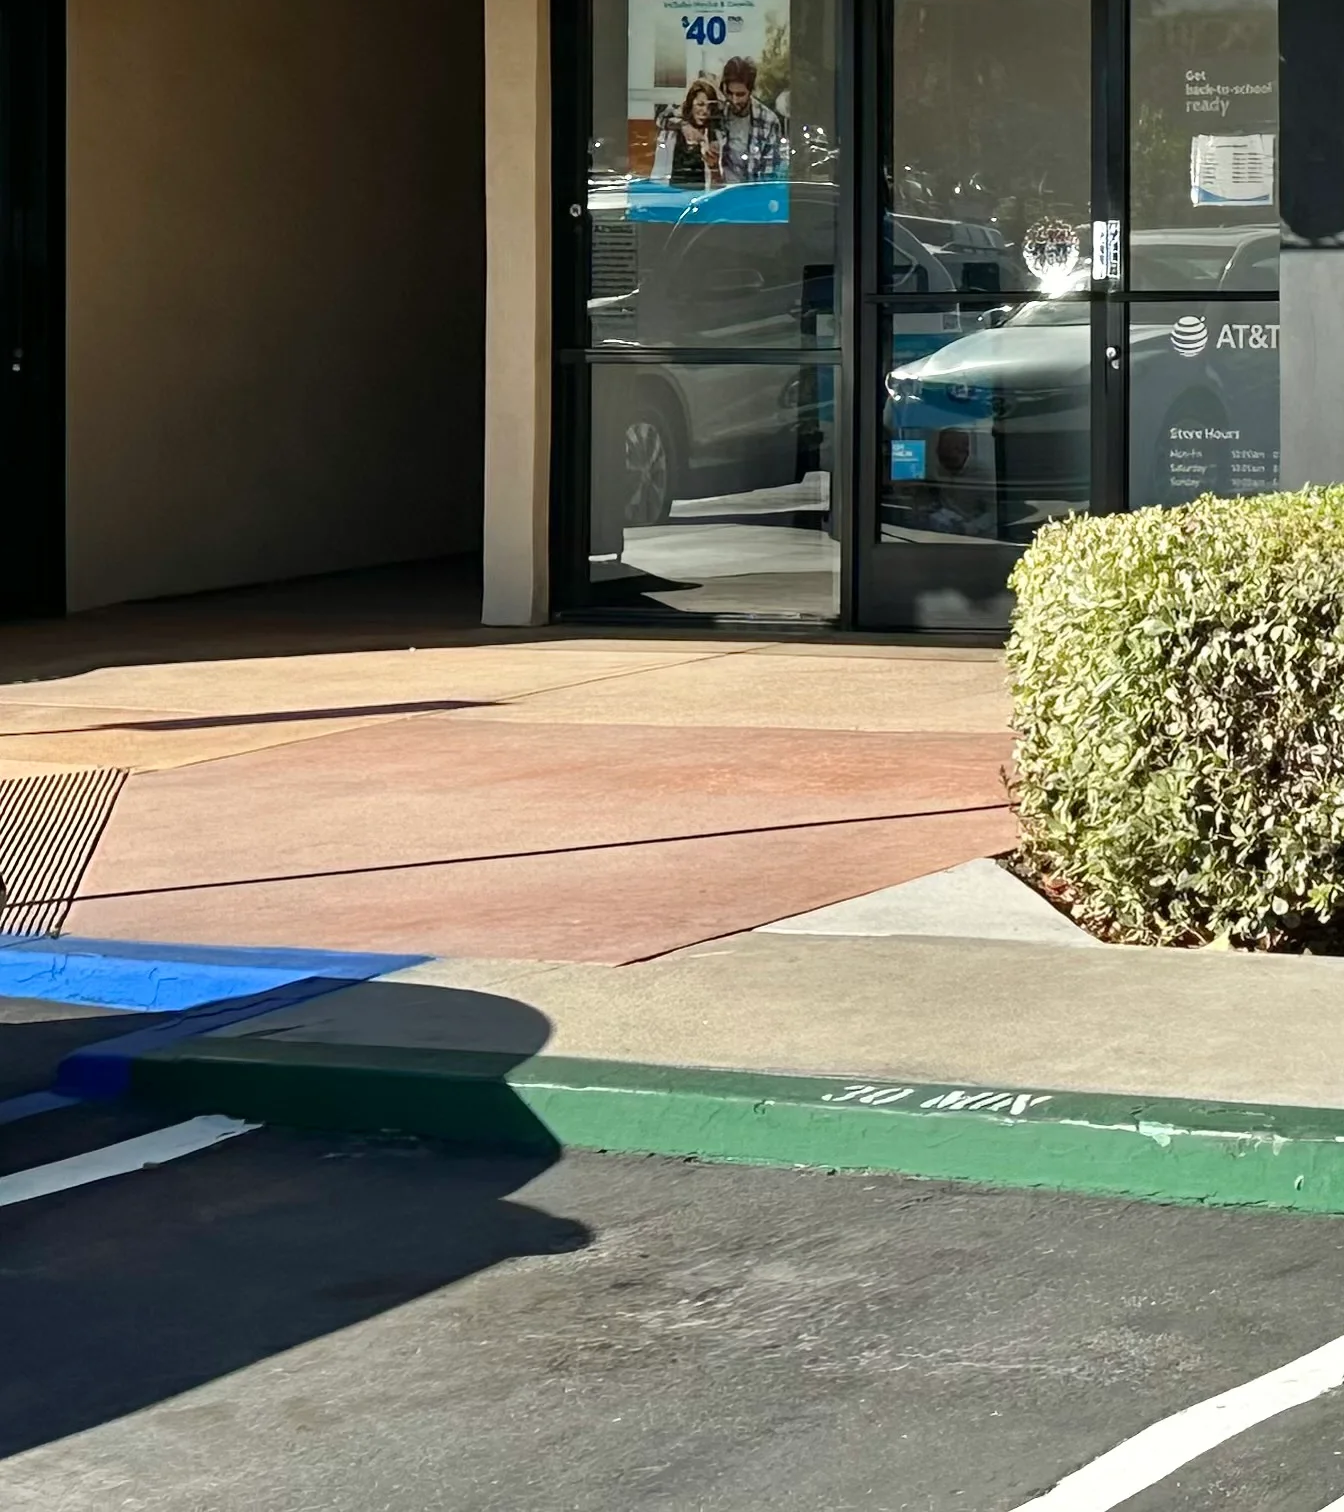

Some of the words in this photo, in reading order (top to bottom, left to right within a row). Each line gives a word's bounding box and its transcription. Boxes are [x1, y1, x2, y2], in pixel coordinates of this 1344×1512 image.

[1185, 70, 1207, 82] Get
[1185, 82, 1273, 96] back-to-school
[1185, 96, 1230, 117] ready
[1216, 323, 1281, 349] AT&T
[821, 1085, 915, 1106] 30
